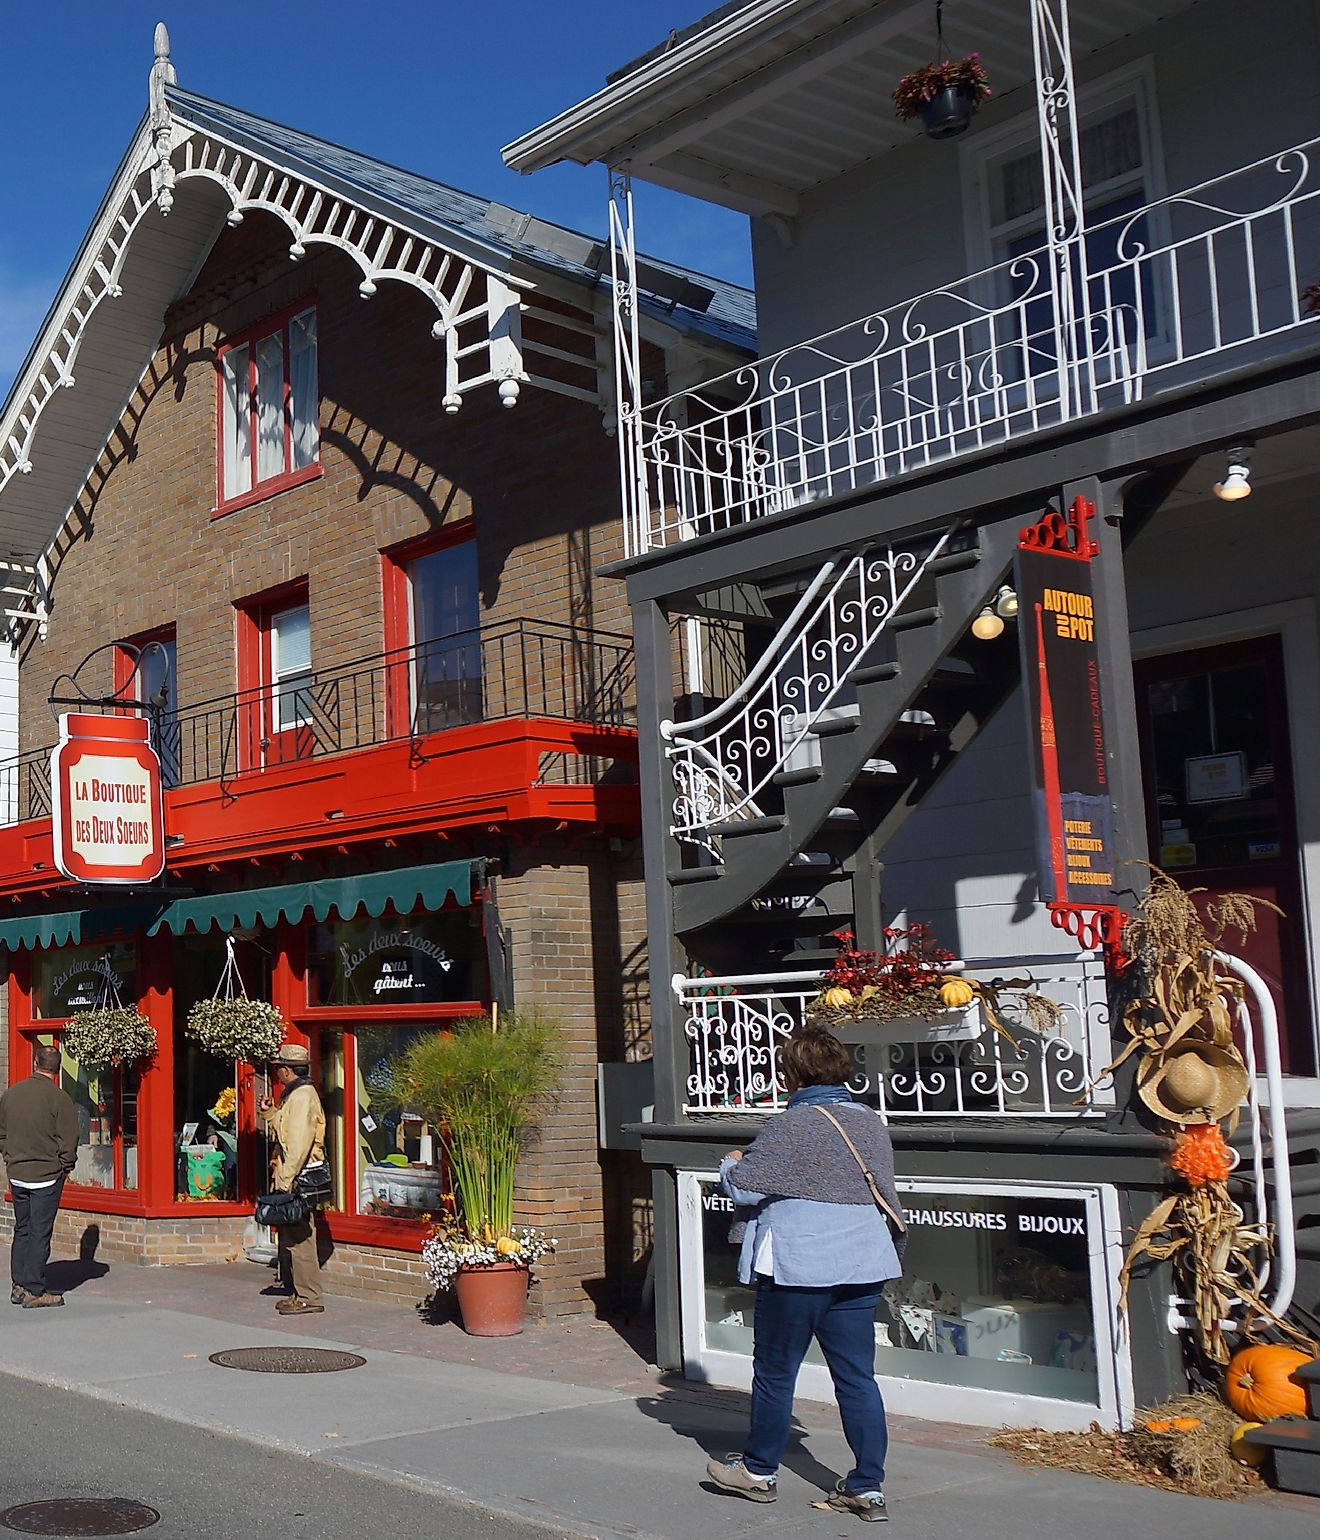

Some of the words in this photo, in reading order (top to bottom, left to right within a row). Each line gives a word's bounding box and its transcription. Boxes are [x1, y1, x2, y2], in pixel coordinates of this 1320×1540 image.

[1044, 588, 1093, 618] AUTOUR
[1056, 614, 1070, 637] DU
[1070, 617, 1094, 641] POT
[75, 781, 88, 801] LA
[76, 820, 91, 843] DES
[1064, 820, 1092, 834] POTERIE
[1065, 836, 1103, 852] VÊTEMENTS
[1067, 854, 1091, 867] BIJOUX
[1068, 871, 1112, 886] ACCESSOIRES
[368, 931, 401, 956] deux
[701, 1194, 735, 1212] VÊTE
[901, 1208, 1007, 1231] CHAUSSURES
[1018, 1214, 1085, 1235] BIJOUX
